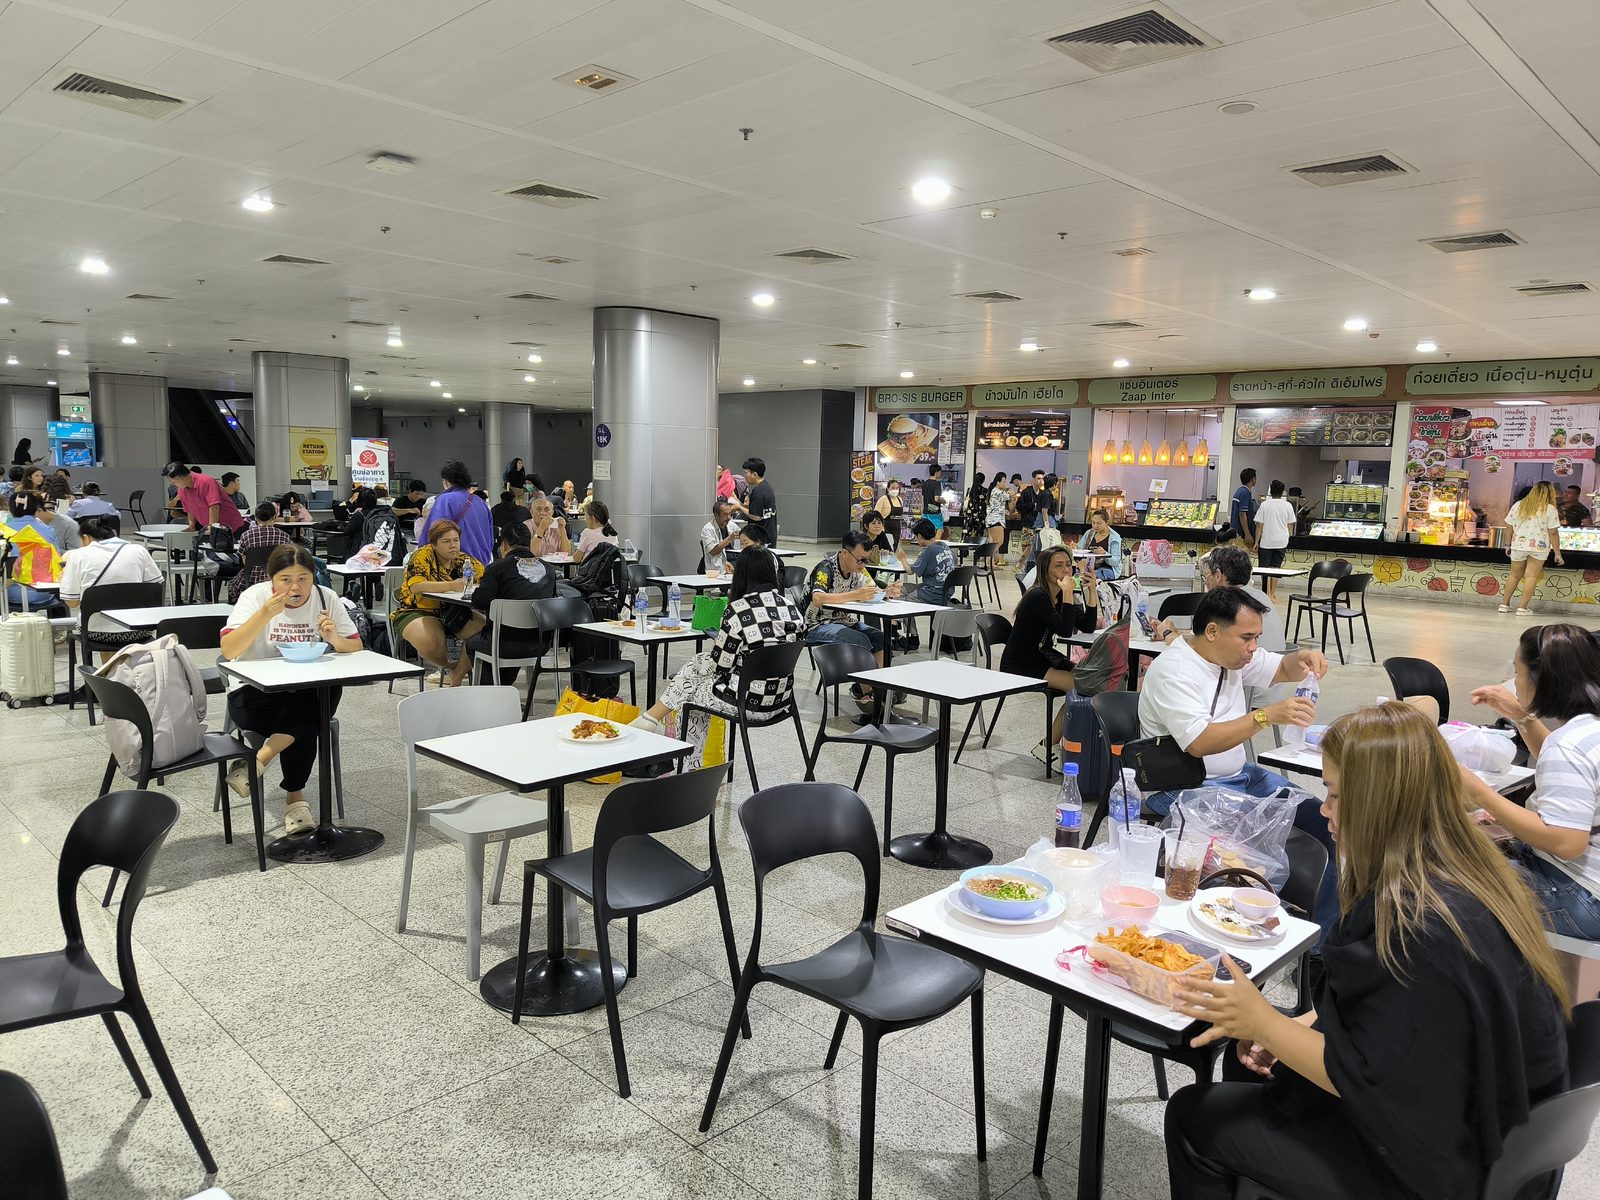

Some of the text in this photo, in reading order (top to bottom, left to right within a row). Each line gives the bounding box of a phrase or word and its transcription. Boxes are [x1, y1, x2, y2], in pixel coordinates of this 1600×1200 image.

[1413, 365, 1594, 385] ก๋วยเตี๋ยว เนื้อตุ๋น-หมูตุ๋น
[1330, 376, 1383, 389] ดิเอ็มไฟร์
[878, 391, 963, 403] BRO-SIS BURGER
[985, 387, 1029, 401] ข้าวมันไก่
[1121, 391, 1176, 402] Zaap Inter
